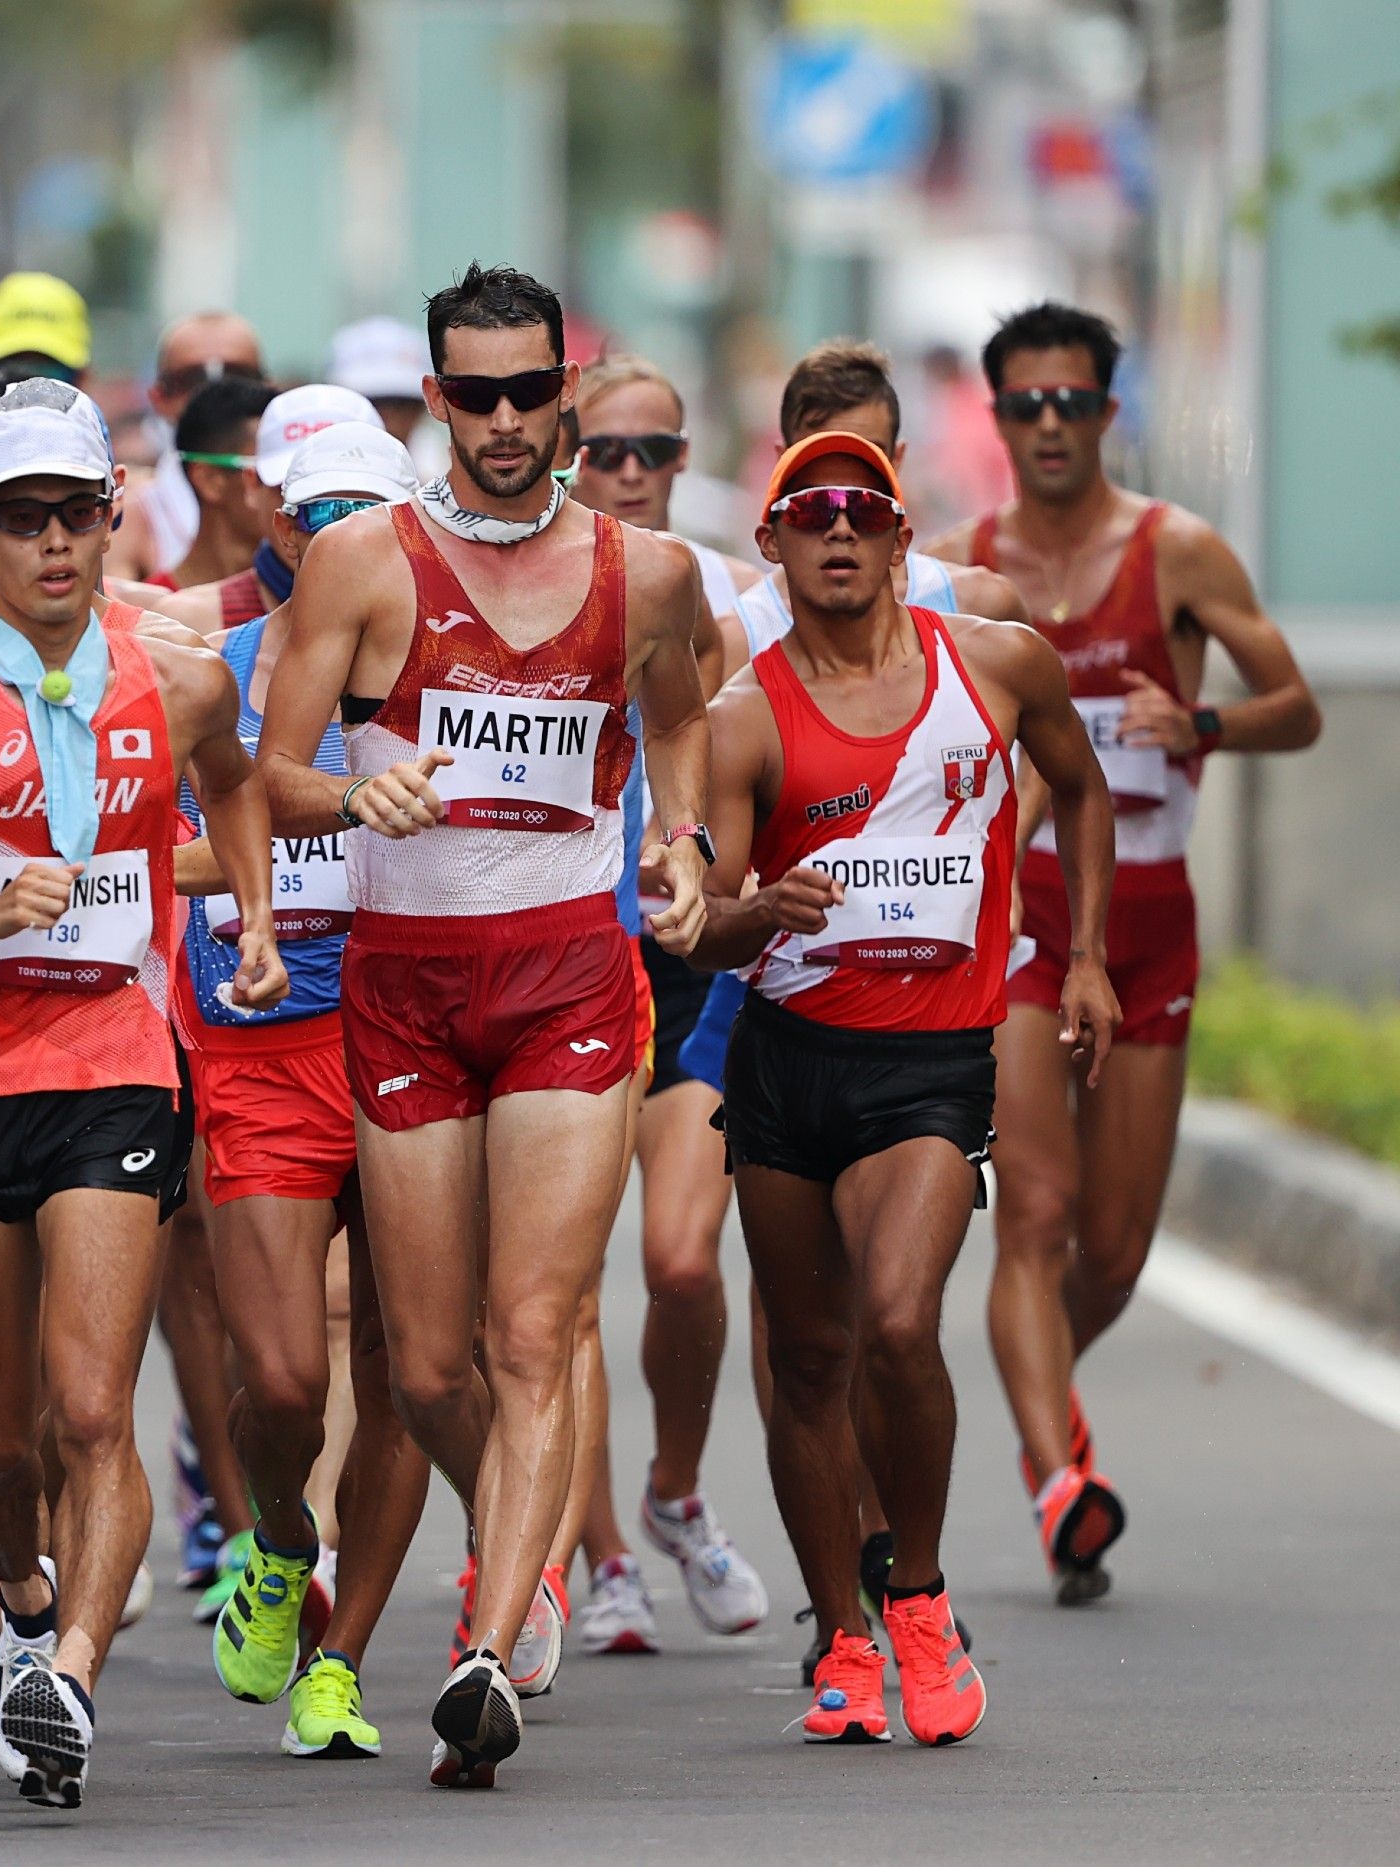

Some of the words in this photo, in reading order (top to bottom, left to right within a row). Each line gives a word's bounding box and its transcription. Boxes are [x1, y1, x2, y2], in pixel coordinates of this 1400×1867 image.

[437, 706, 589, 756] MARTIN
[947, 747, 984, 761] PERU
[501, 763, 527, 783] 62
[0, 776, 144, 819] JAAN
[806, 783, 871, 825] PERÚ
[469, 808, 498, 819] TOKYO
[499, 810, 520, 820] 2020
[279, 874, 303, 893] 35
[878, 902, 915, 921] 154
[857, 948, 886, 959] TOKYO
[886, 947, 908, 958] 2020
[18, 966, 48, 978] TOKYO
[48, 969, 72, 980] 2020
